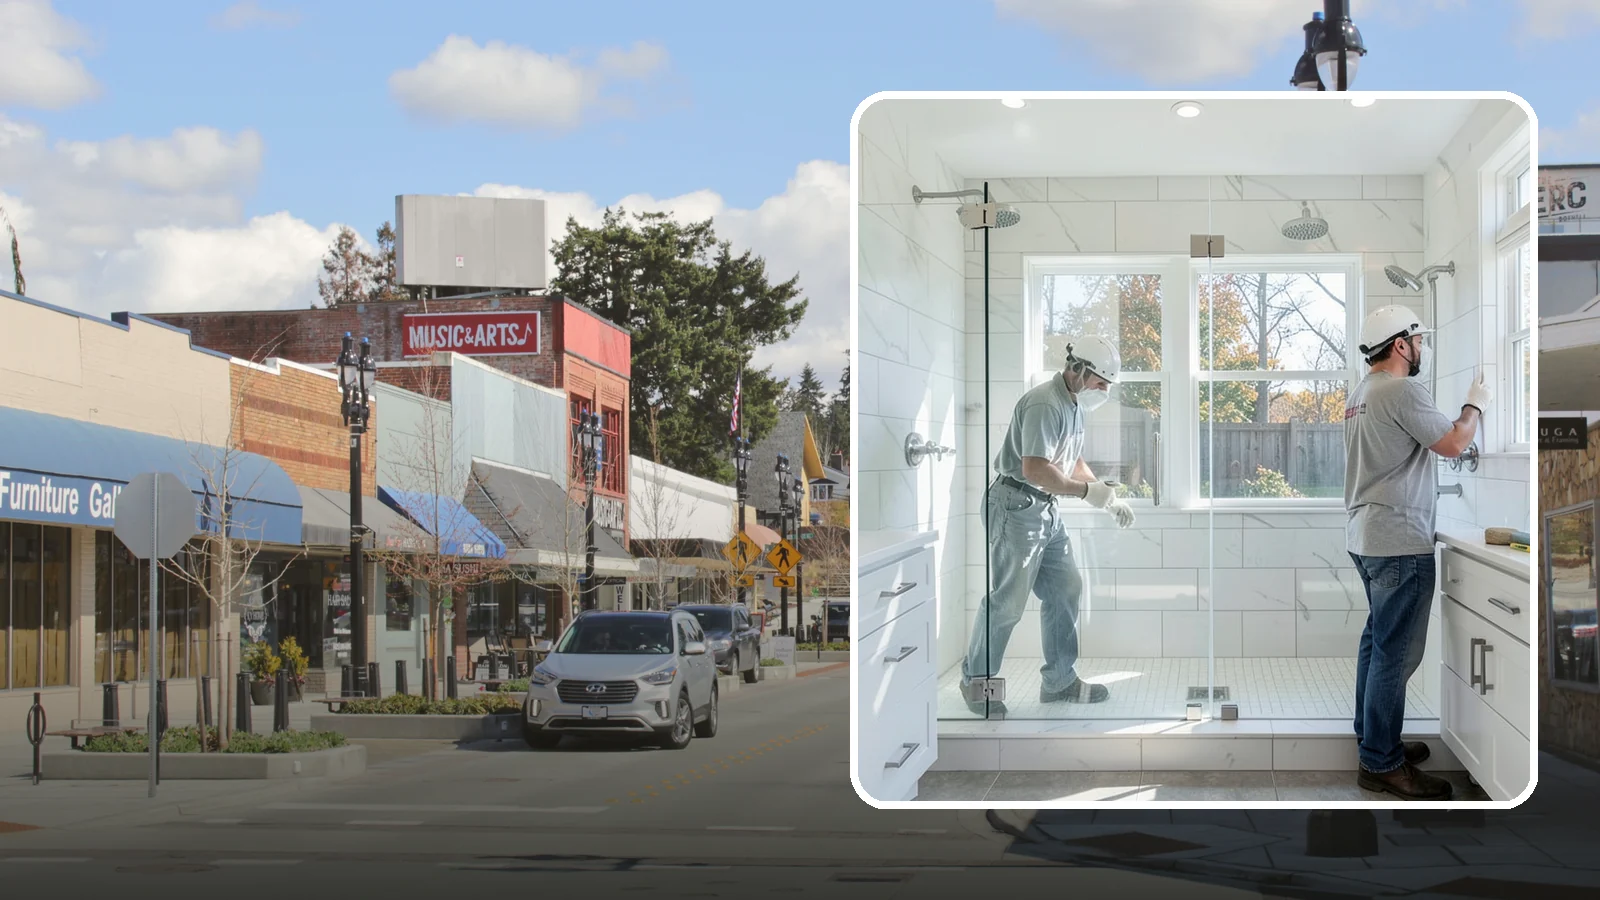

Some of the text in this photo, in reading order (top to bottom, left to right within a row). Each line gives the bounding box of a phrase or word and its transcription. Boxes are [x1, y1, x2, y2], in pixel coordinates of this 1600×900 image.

[0, 471, 121, 519] Furniture Gal
[452, 562, 480, 575] SUSHI
